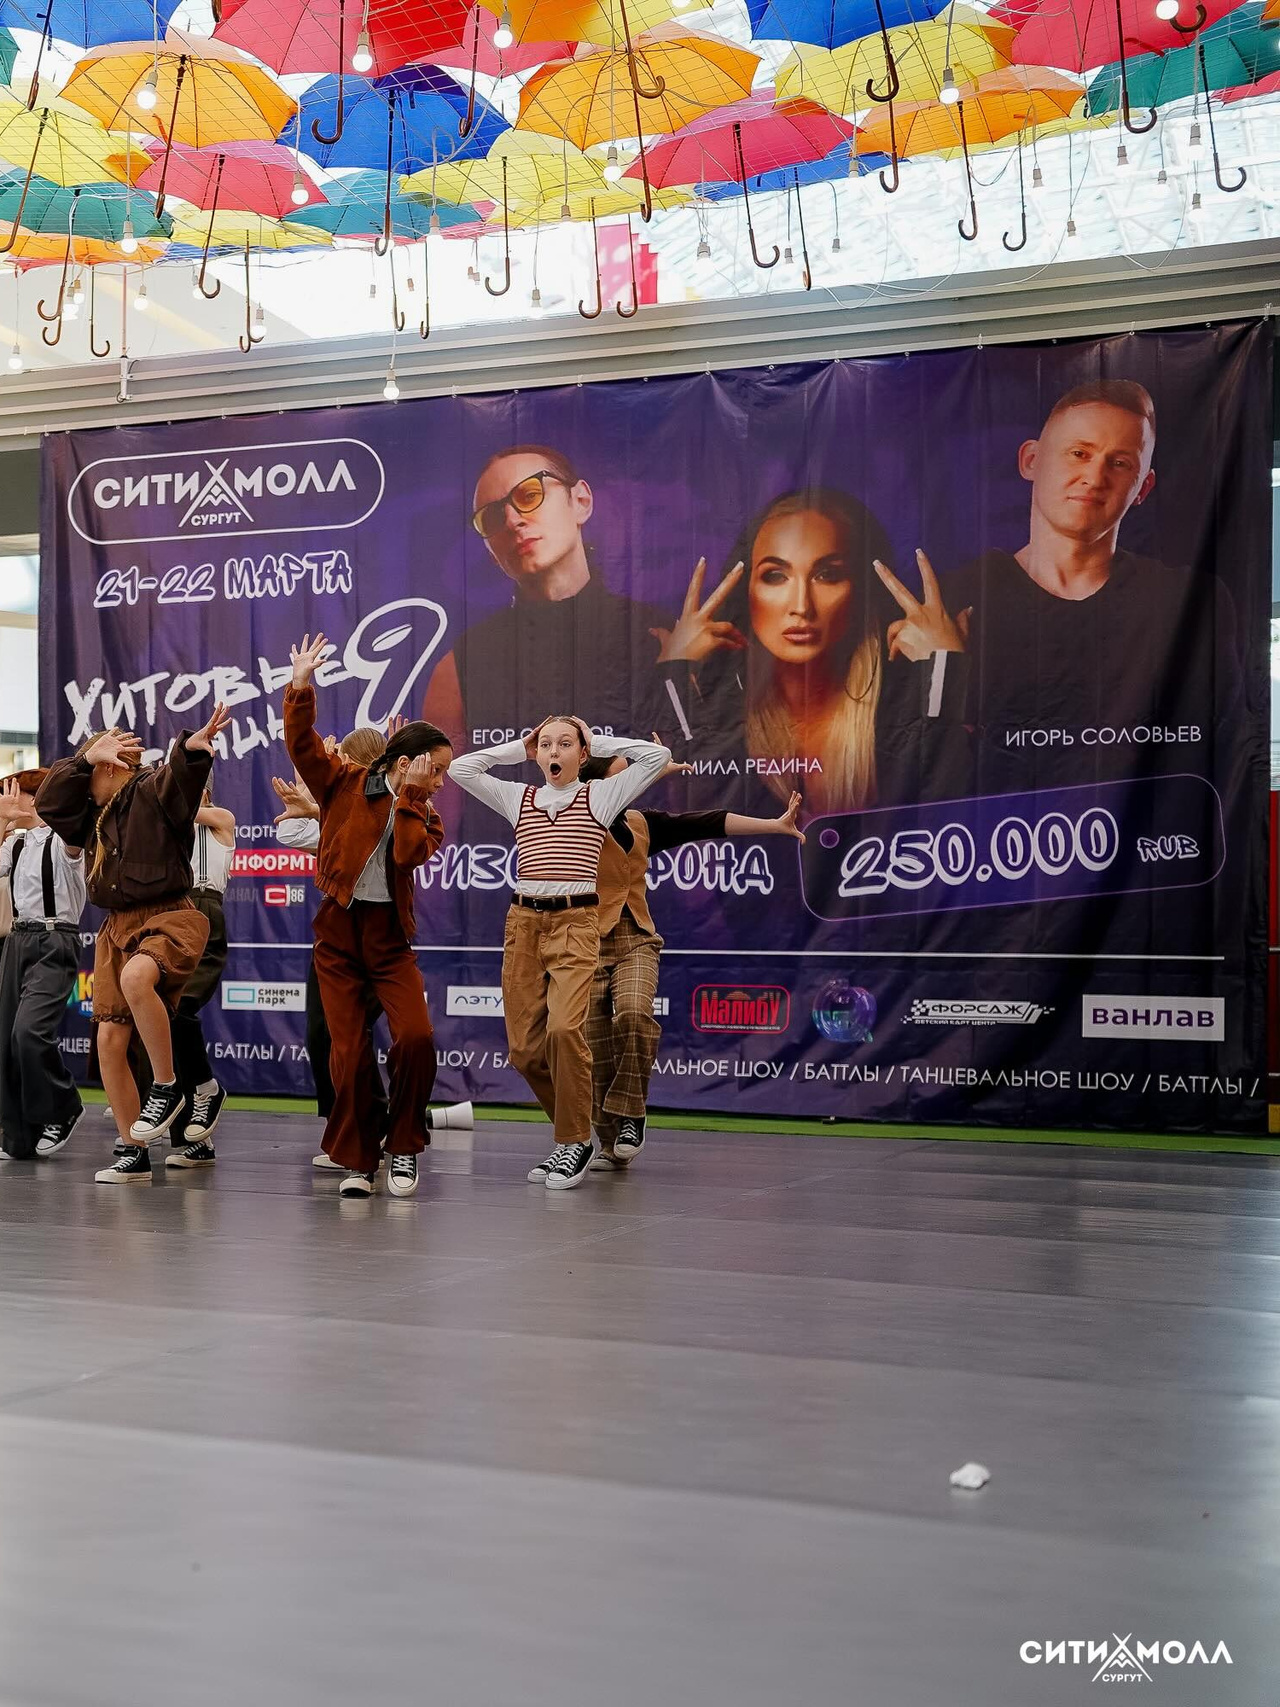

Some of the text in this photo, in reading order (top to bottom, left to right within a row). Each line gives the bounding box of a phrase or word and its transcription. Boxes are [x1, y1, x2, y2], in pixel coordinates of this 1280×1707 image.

[190, 511, 241, 527] СУРГУТ
[93, 550, 353, 608] 21-22 МАРТА
[472, 728, 516, 745] ЕГОР
[1005, 725, 1202, 747] ИГОРЬ СОЛОВЬЕВ
[681, 757, 824, 776] МИЛА РЕДИНА
[837, 806, 1201, 898] 250.000 RUB
[257, 988, 300, 998] синема
[257, 996, 287, 1006] парк
[931, 1003, 1023, 1014] ФОРСАЖ
[1091, 1007, 1215, 1028] ванлав
[214, 1042, 274, 1060] БАТТЛЫ
[733, 1060, 784, 1079] ШОУ
[804, 1063, 880, 1083] БАТТЛЫ
[899, 1066, 1071, 1089] ТАНЦЕВАЛЬНОЕ
[1078, 1072, 1135, 1091] ШОУ
[1158, 1075, 1243, 1095] БАТТЛЫ
